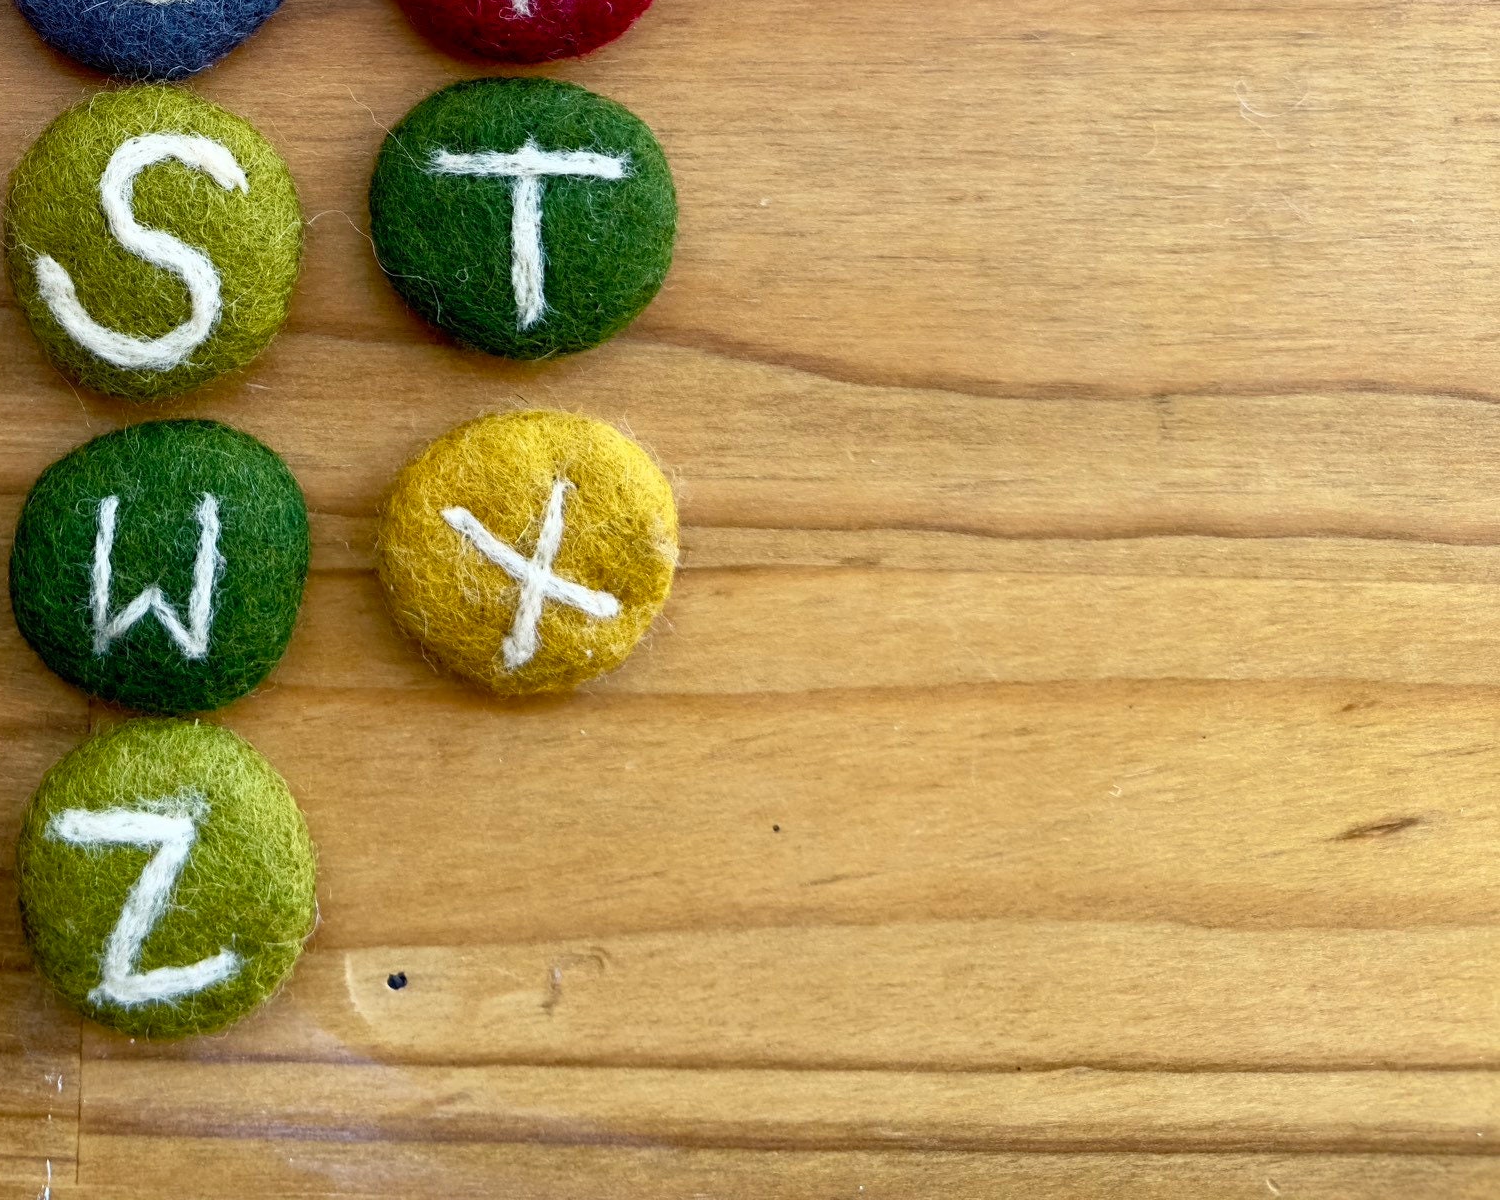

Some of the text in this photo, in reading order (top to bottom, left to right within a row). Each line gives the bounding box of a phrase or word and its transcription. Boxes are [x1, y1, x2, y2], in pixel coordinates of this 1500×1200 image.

[37, 134, 249, 367] S
[434, 142, 627, 326] T
[93, 493, 223, 660] W
[442, 481, 620, 666] X
[52, 797, 236, 1004] Z
